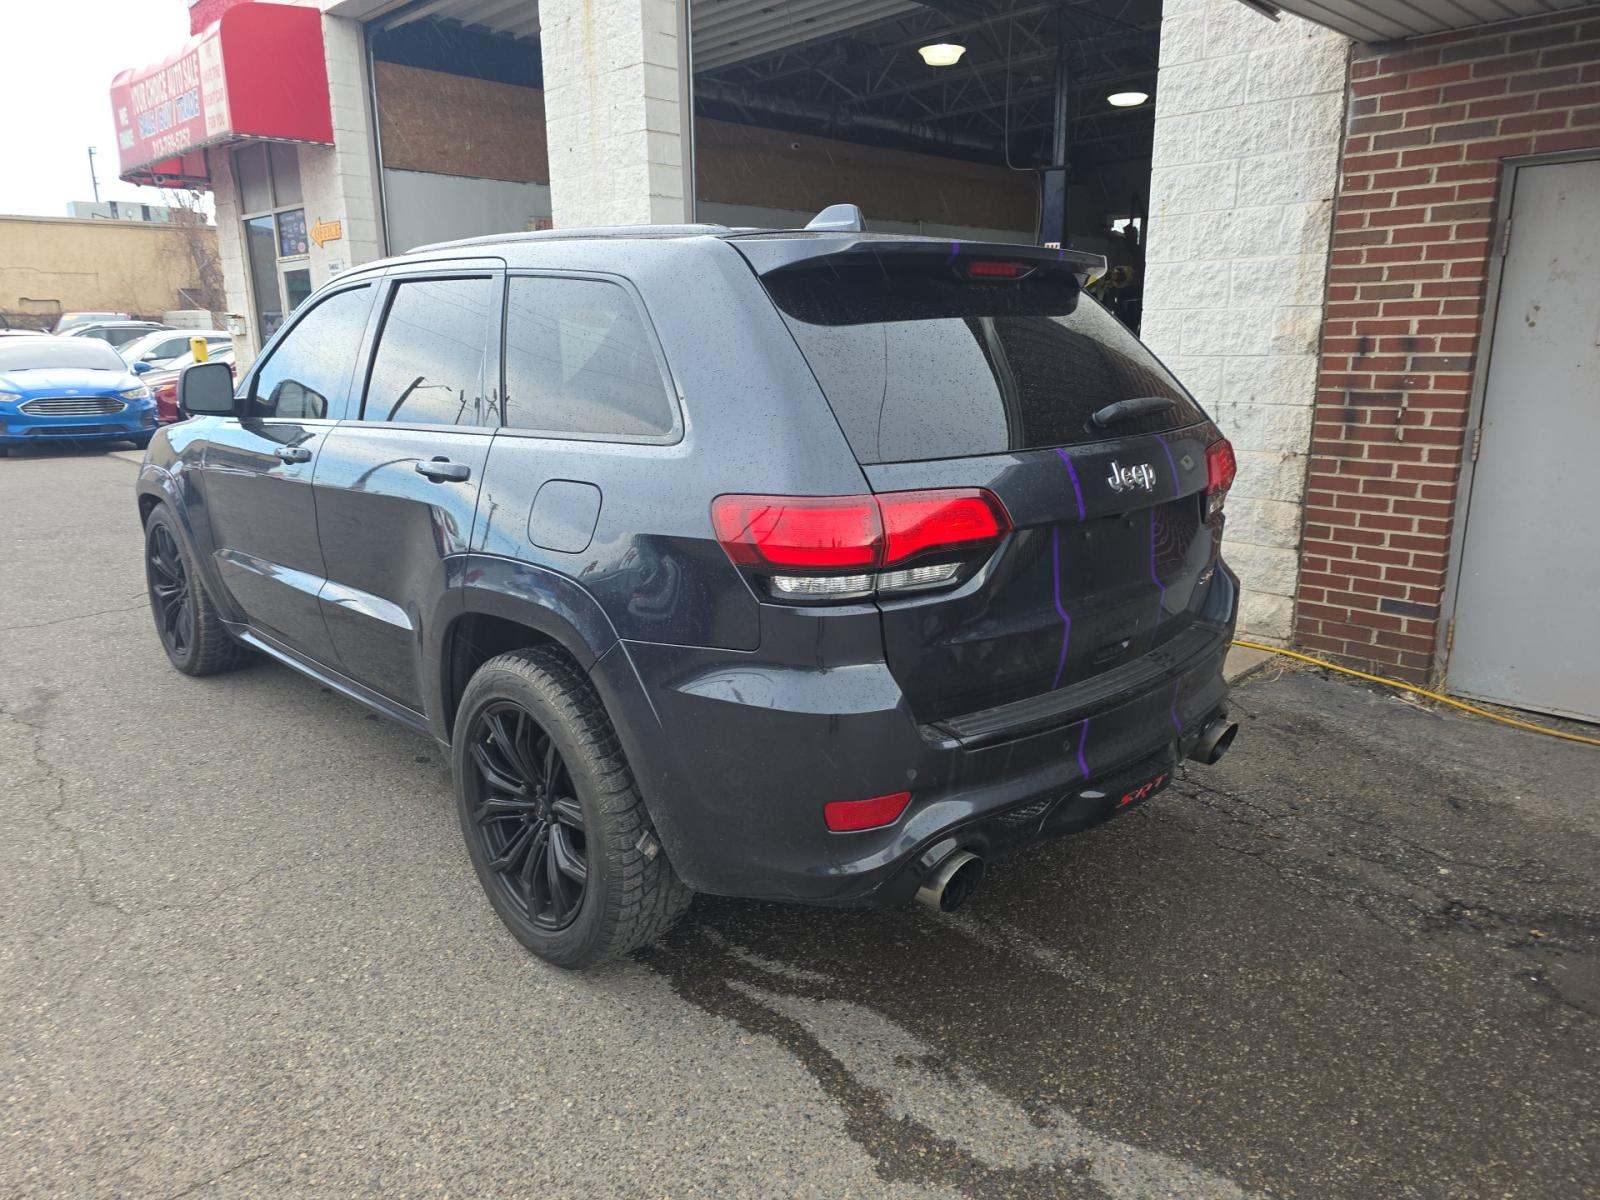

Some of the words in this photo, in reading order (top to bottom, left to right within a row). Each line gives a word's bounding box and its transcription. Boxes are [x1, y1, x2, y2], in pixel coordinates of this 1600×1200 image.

[166, 61, 183, 99] AUTO
[176, 86, 200, 124] TRADE
[313, 223, 340, 240] OFFICE
[1107, 459, 1156, 491] Jeep
